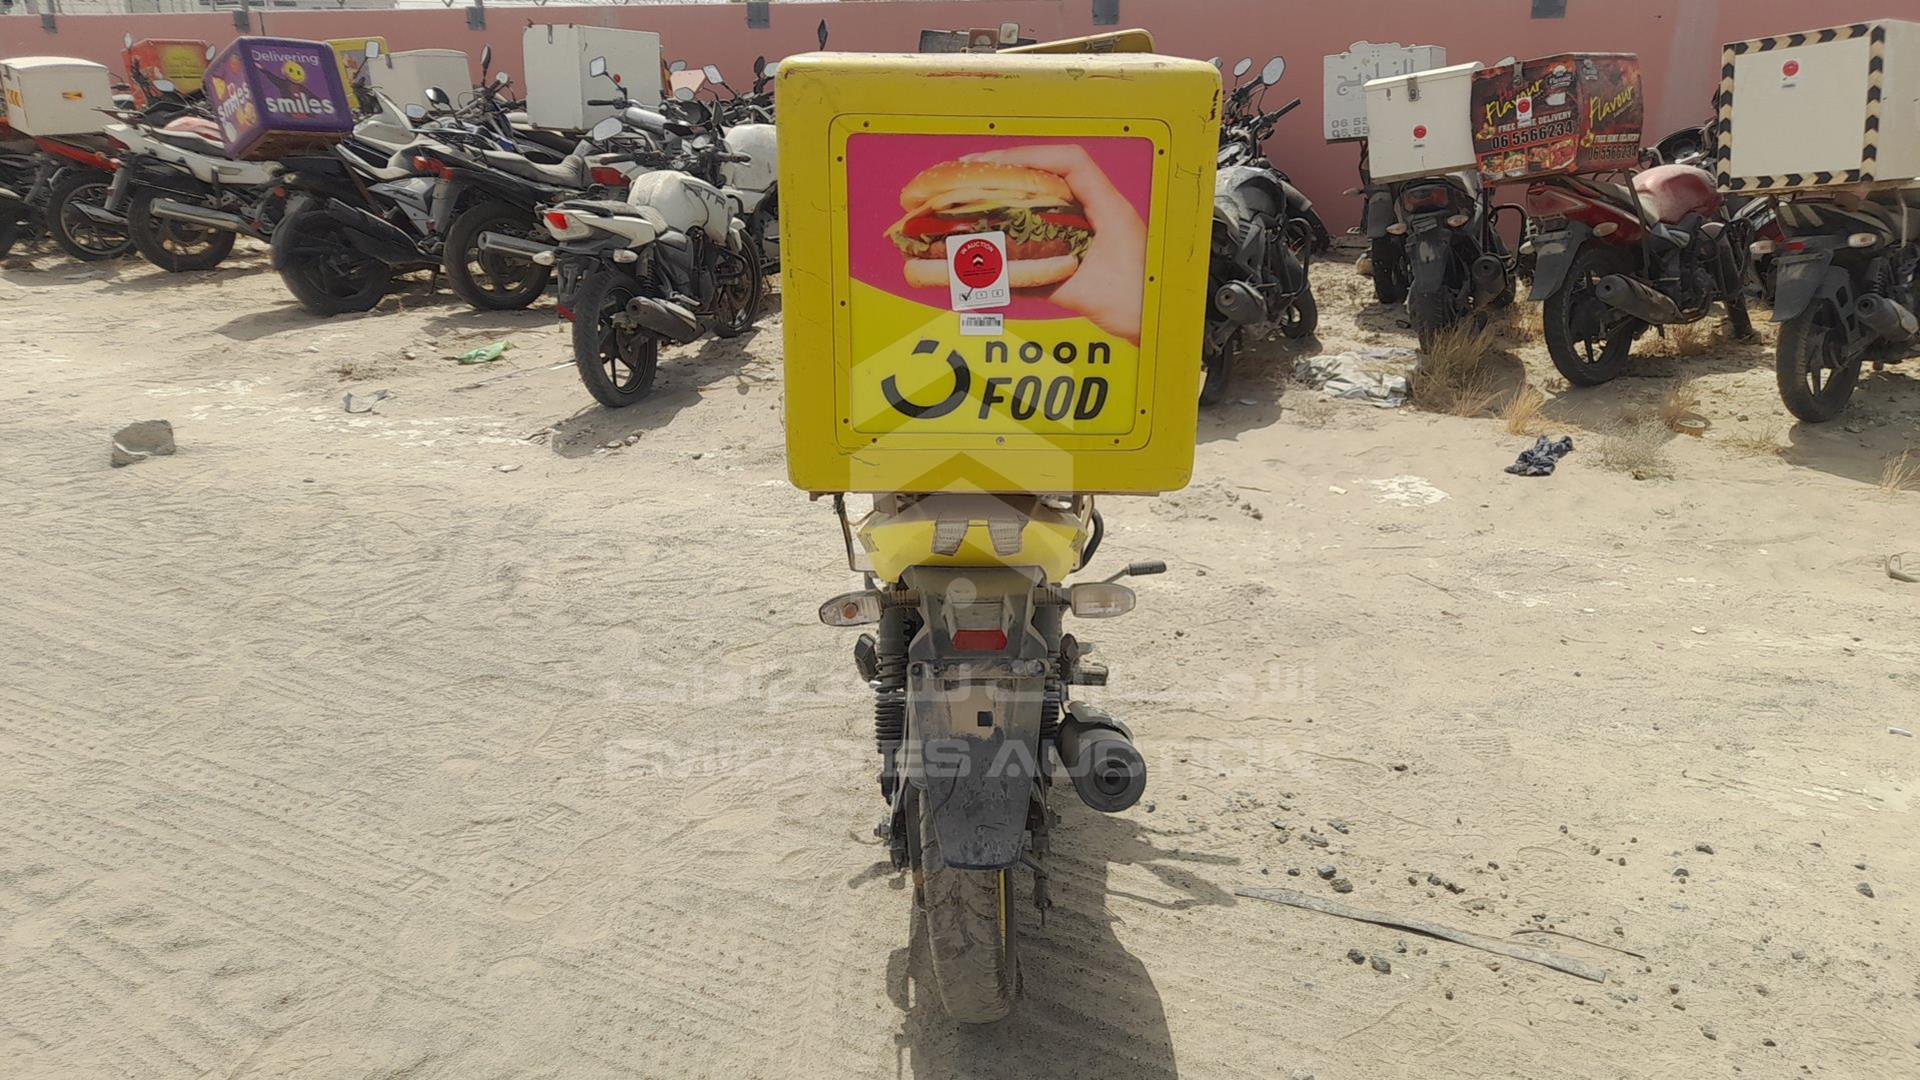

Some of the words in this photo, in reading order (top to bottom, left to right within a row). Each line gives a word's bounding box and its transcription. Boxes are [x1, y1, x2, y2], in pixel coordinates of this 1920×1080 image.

[252, 50, 319, 65] Delivering
[217, 82, 250, 121] smiles
[265, 92, 335, 114] smiles
[1590, 86, 1634, 129] Flavour
[1537, 111, 1573, 124] DELIVERY
[1492, 135, 1508, 149] 06
[1512, 121, 1574, 146] 5566234
[967, 241, 994, 253] AUCTION
[985, 341, 1110, 364] noon
[978, 376, 1108, 420] FOOD
